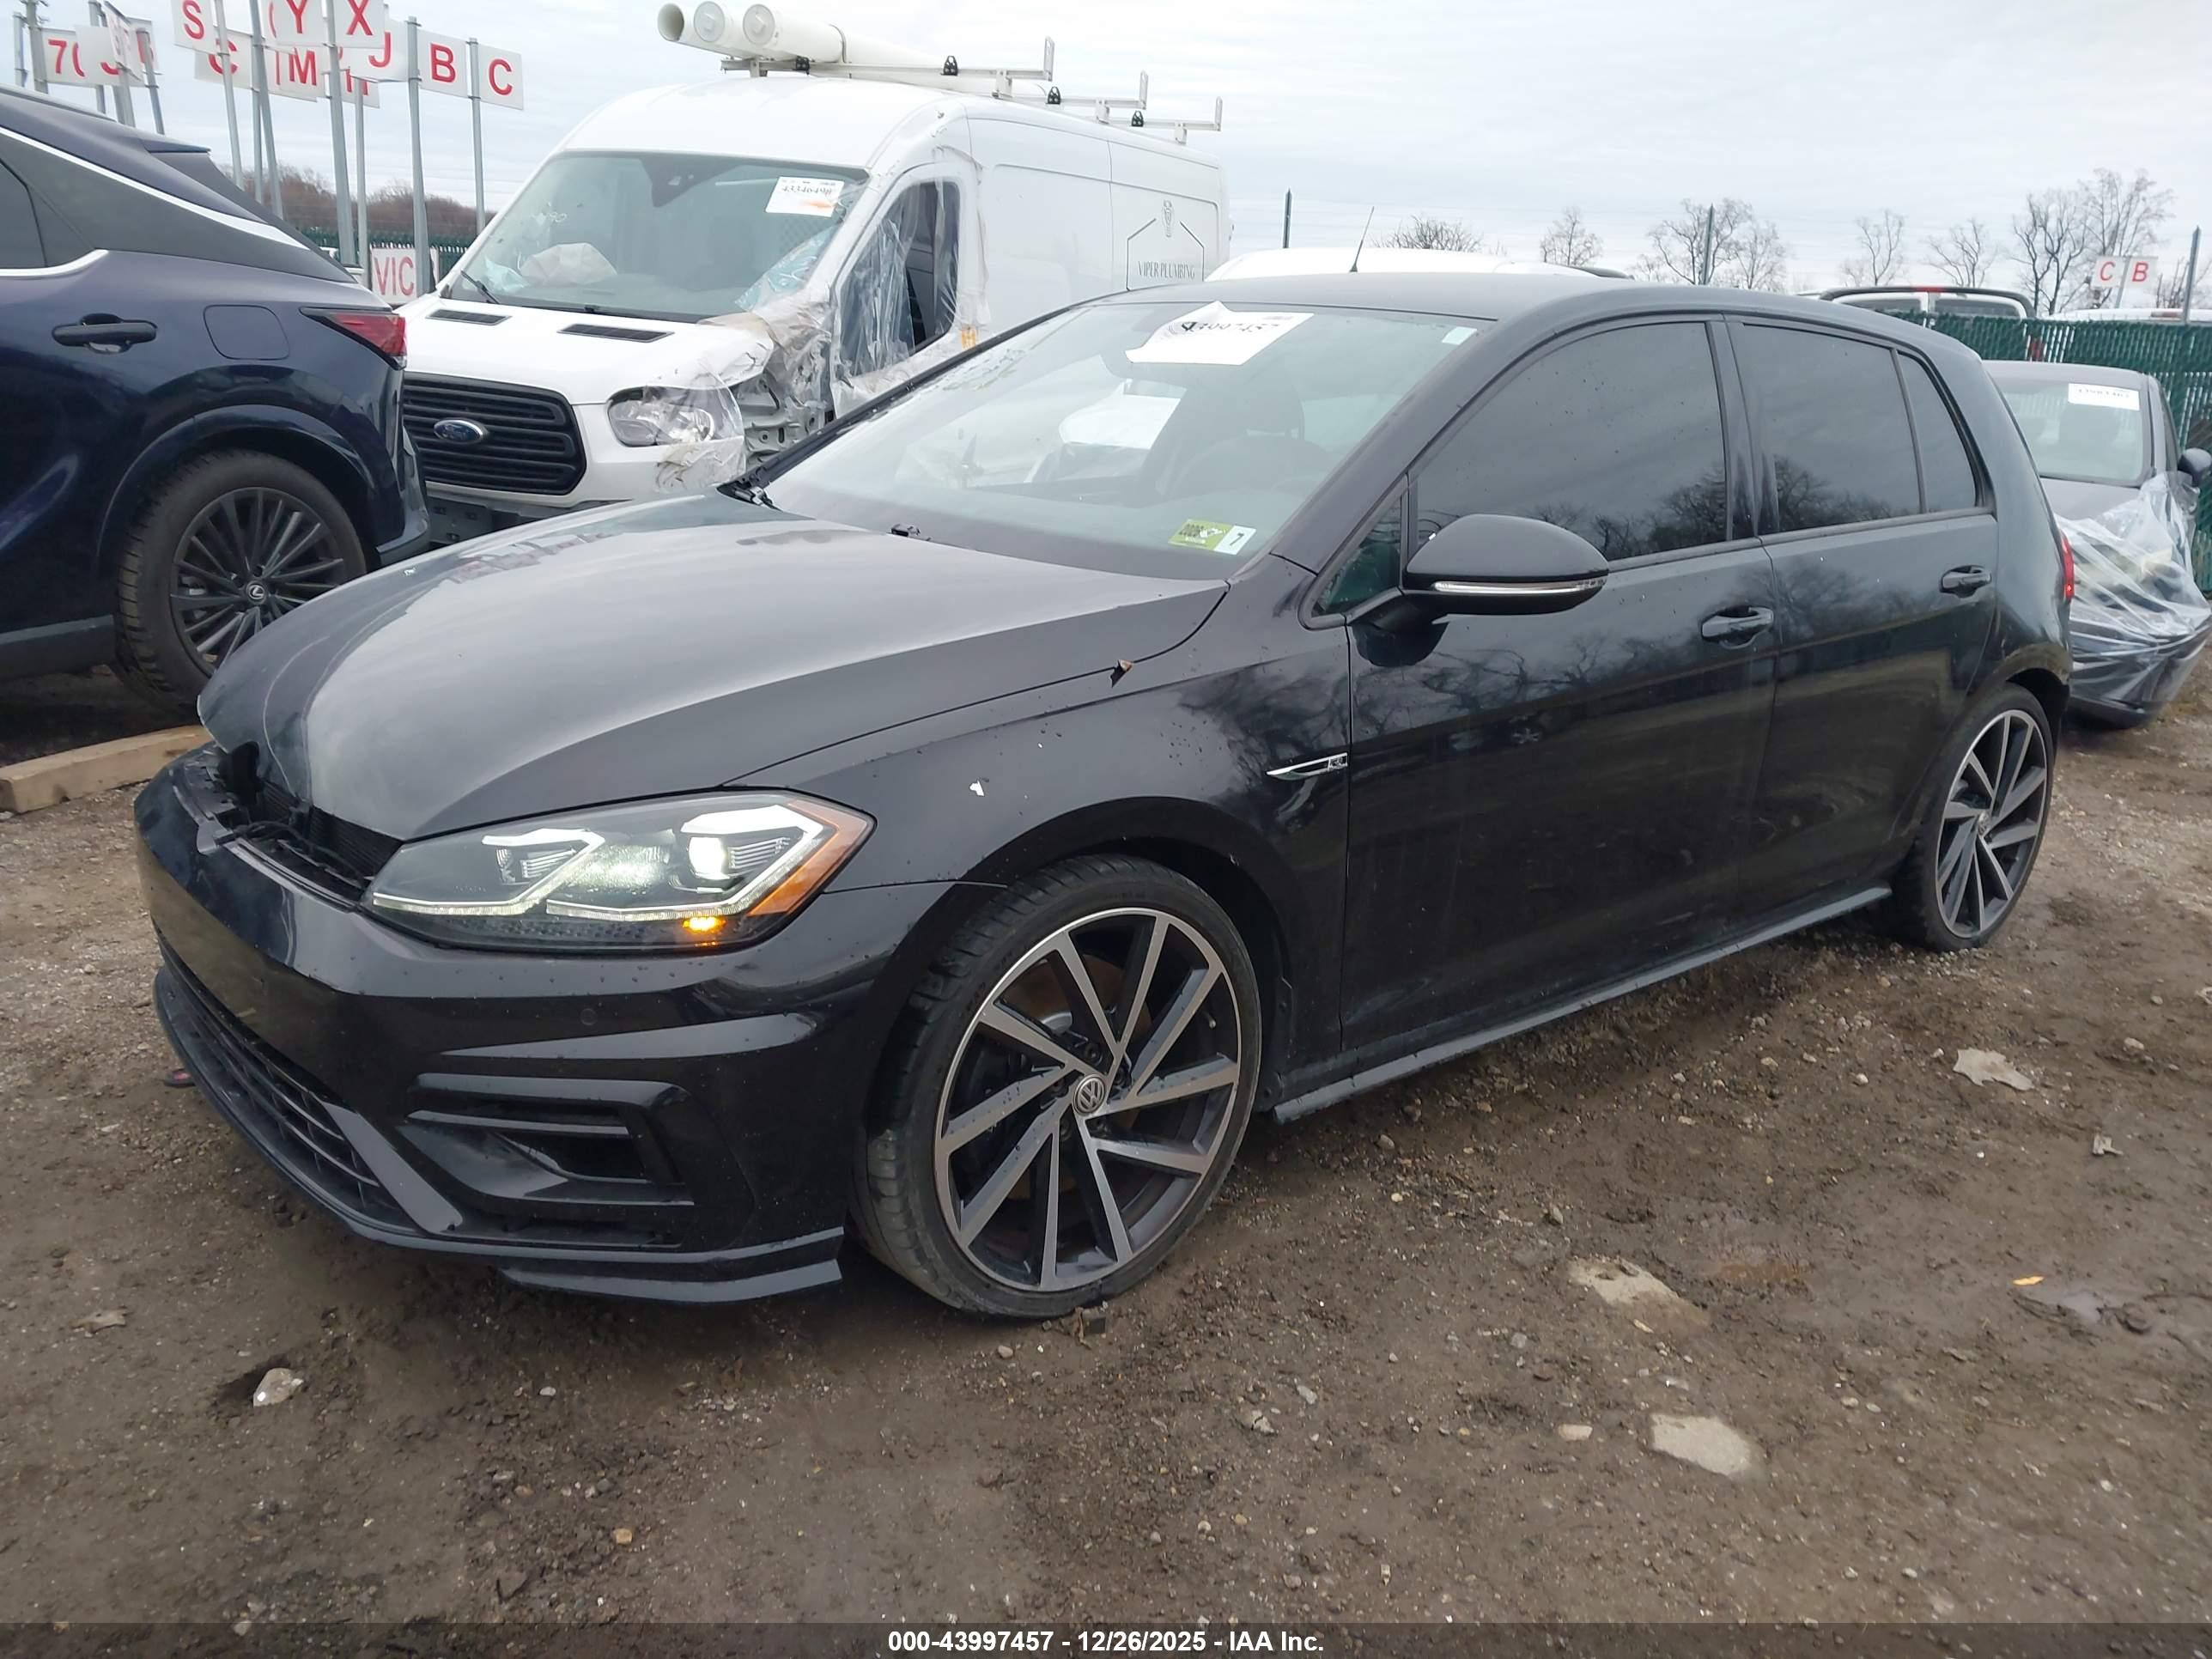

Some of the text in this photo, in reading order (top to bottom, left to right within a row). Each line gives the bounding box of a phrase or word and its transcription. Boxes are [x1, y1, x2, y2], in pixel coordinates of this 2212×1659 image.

[182, 0, 204, 40] S
[287, 0, 308, 34] Y
[346, 0, 373, 36] X
[368, 31, 392, 68] J
[430, 43, 456, 83] B
[488, 58, 514, 96] C
[374, 256, 415, 296] VIC
[1138, 260, 1195, 280] VIPER PLUMBING
[2100, 261, 2116, 282] C
[2132, 262, 2149, 283] B
